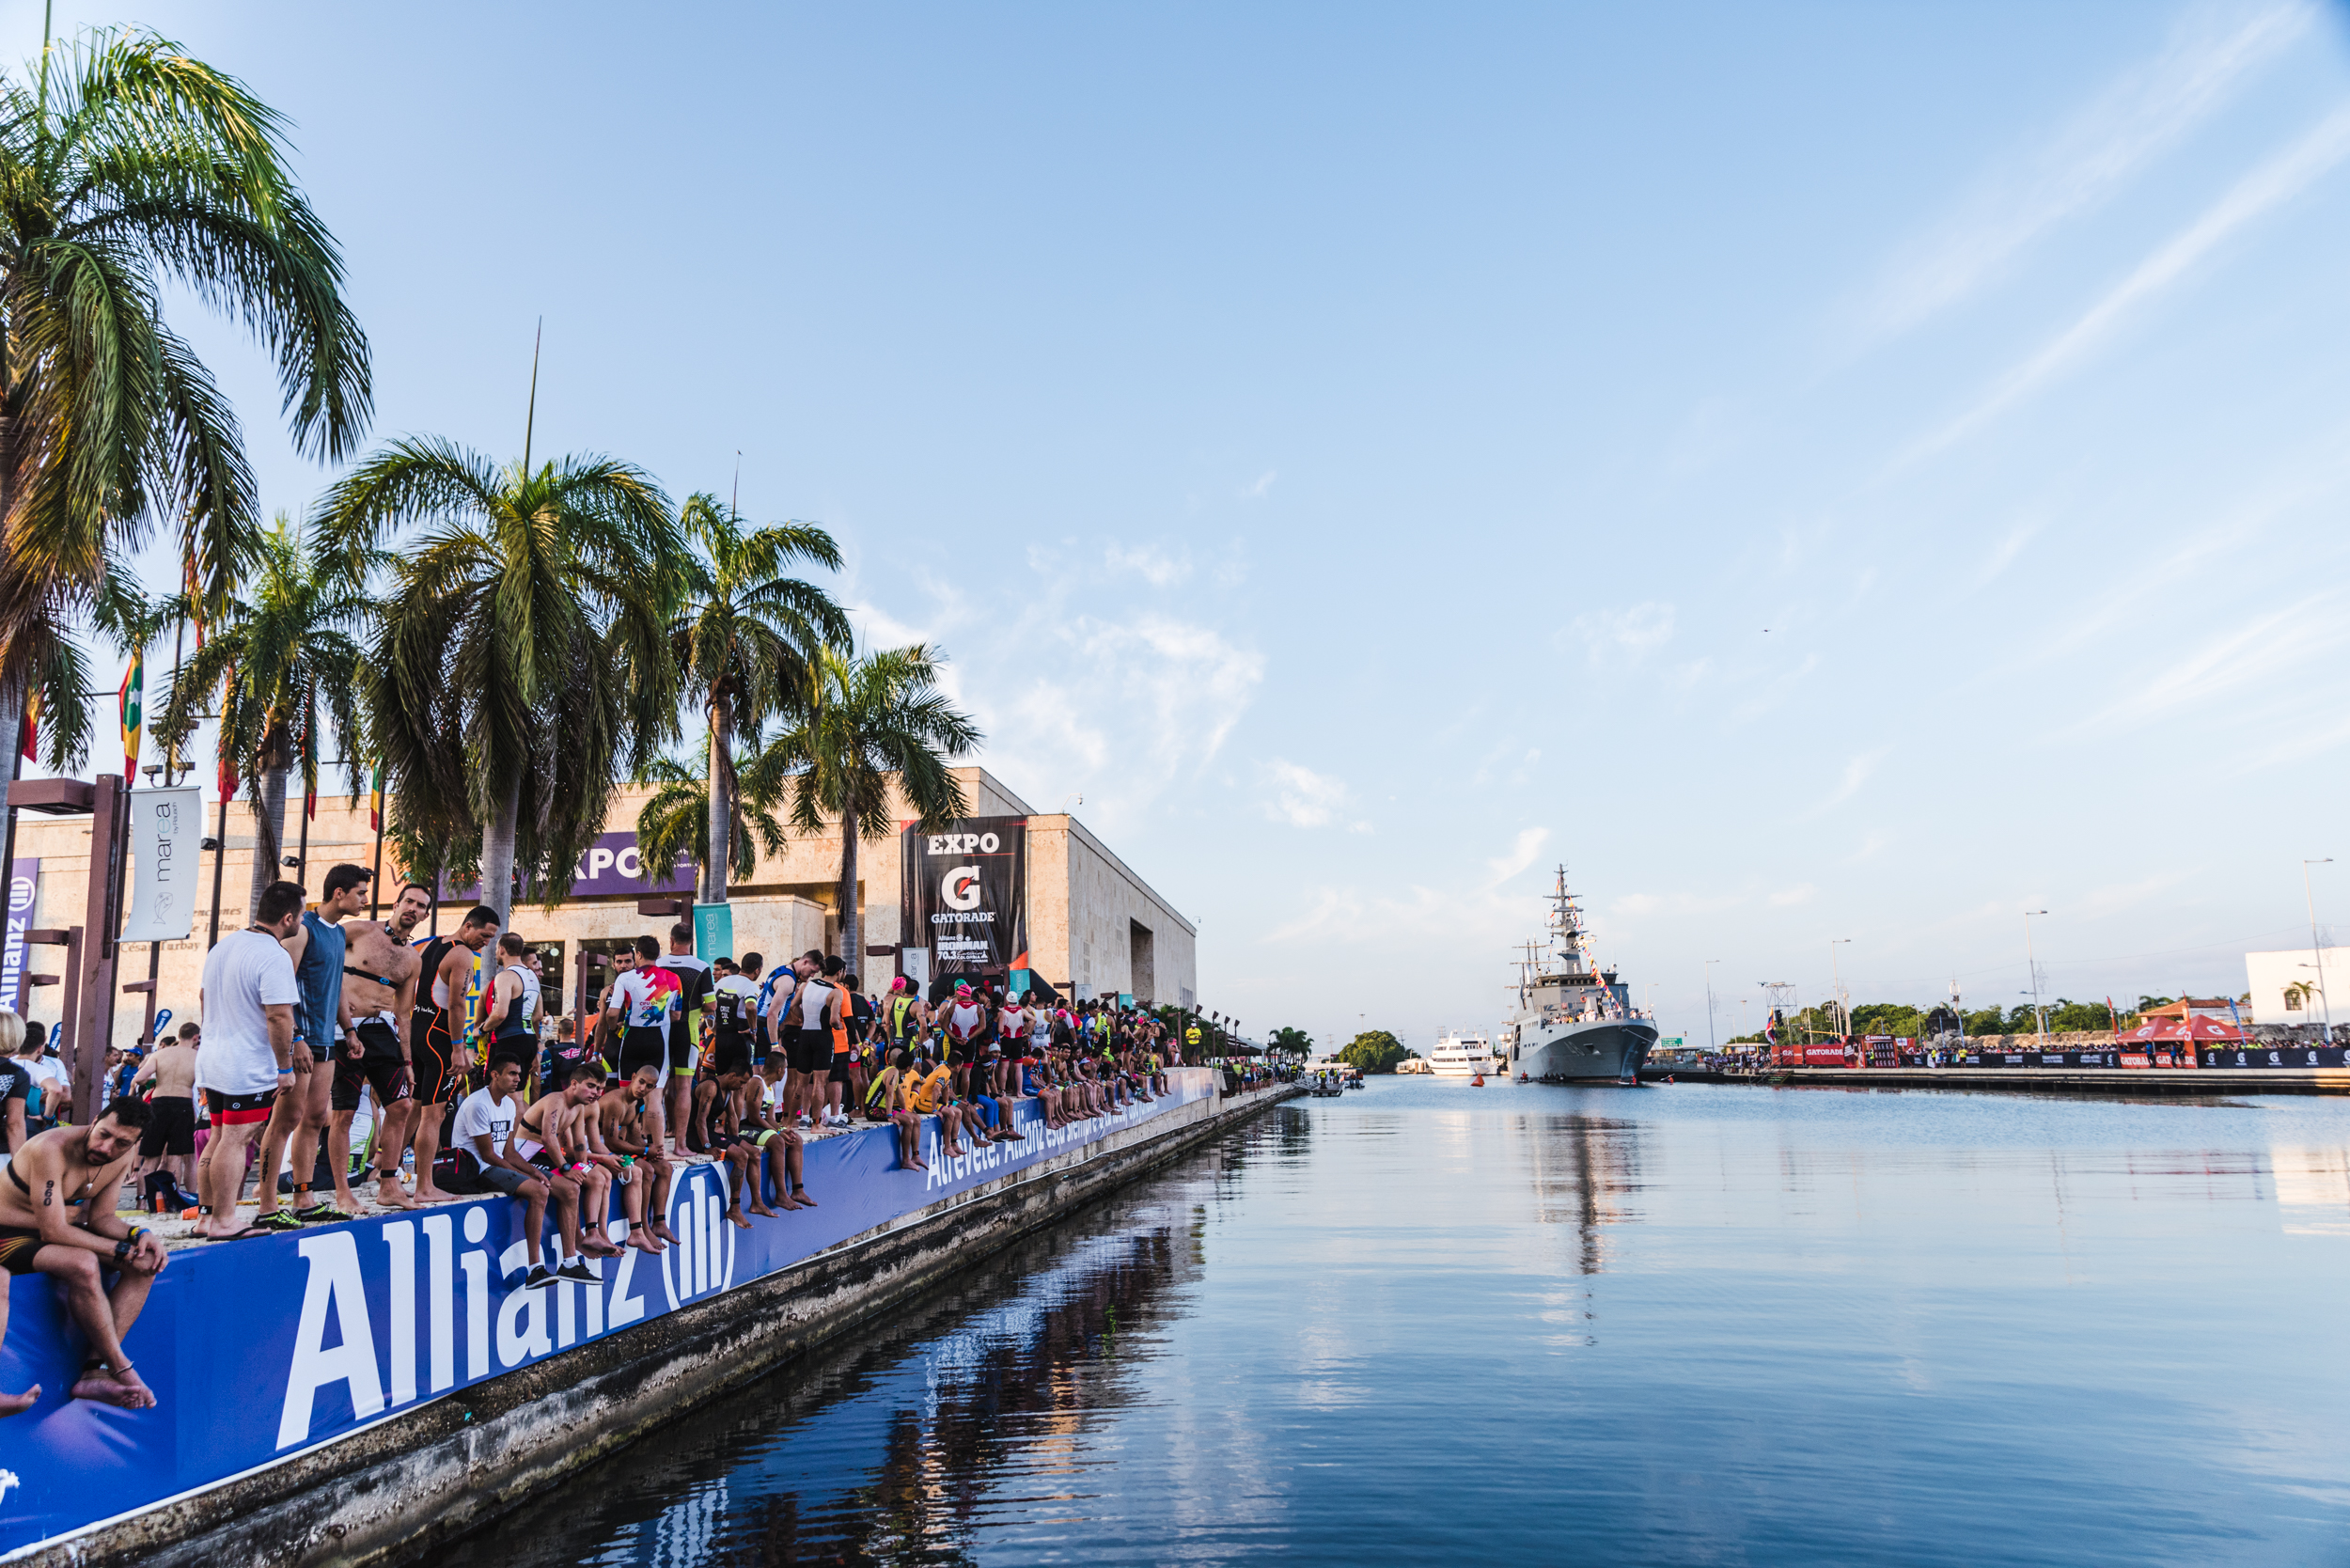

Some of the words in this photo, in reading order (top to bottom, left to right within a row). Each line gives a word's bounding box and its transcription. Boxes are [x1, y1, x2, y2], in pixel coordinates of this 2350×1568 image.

[156, 802, 172, 882] marea
[927, 832, 1000, 855] EXPO
[941, 865, 981, 911] G
[705, 913, 716, 956] marea
[931, 912, 995, 924] GATORADE
[937, 940, 989, 951] IRONMAN
[937, 950, 957, 961] 70.3
[275, 1206, 645, 1451] Allianz
